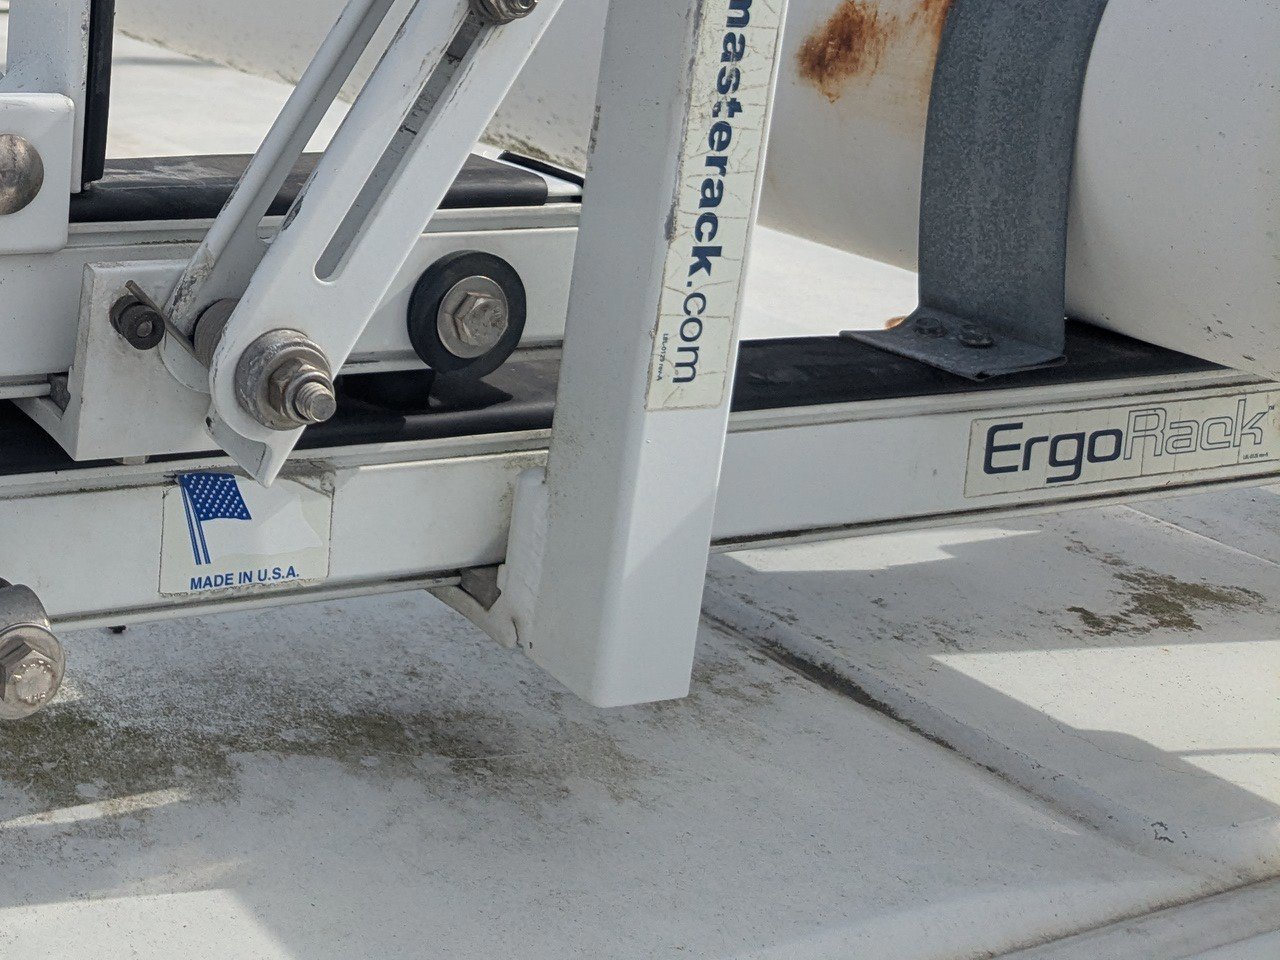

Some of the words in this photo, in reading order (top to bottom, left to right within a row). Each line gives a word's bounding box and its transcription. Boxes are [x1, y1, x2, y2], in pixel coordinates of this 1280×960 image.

[983, 398, 1269, 484] ErgoRack
[190, 573, 233, 590] MADE
[238, 571, 253, 584] IN
[257, 566, 299, 582] U.S.A.
